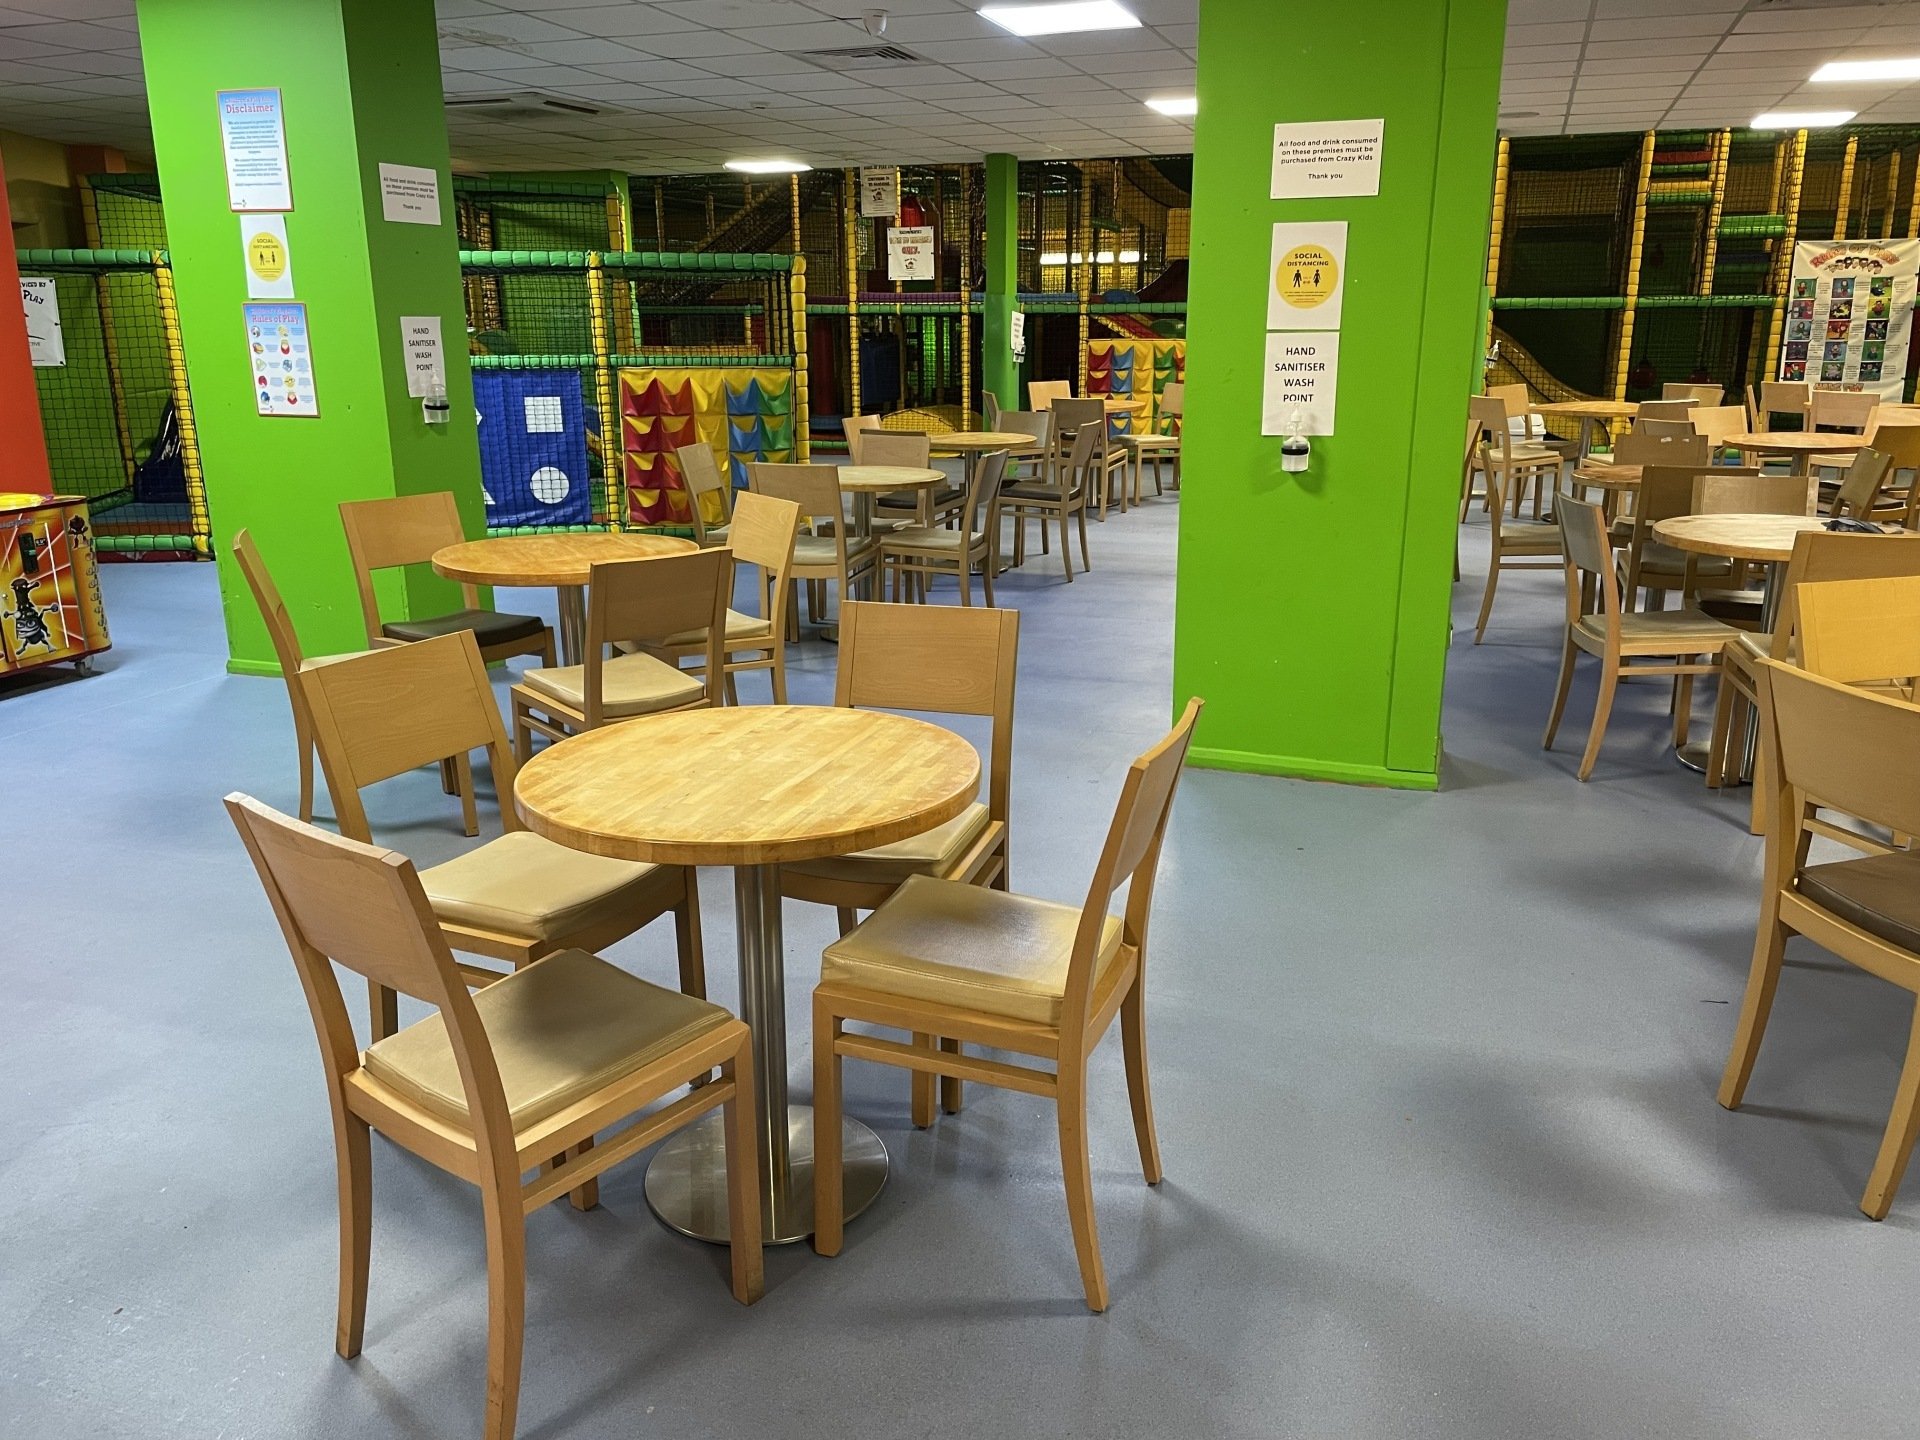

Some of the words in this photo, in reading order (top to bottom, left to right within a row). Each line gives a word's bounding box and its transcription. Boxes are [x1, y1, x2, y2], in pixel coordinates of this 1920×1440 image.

[225, 103, 274, 113] Disclaimer
[1322, 138, 1340, 146] drink
[1312, 147, 1343, 155] premises
[1281, 157, 1316, 165] purchased
[1336, 155, 1356, 163] Crazy
[282, 314, 299, 324] Play
[1286, 347, 1316, 356] HAND
[1274, 363, 1325, 371] SANITISER
[1284, 379, 1315, 387] WASH
[1283, 394, 1314, 402] POINT
